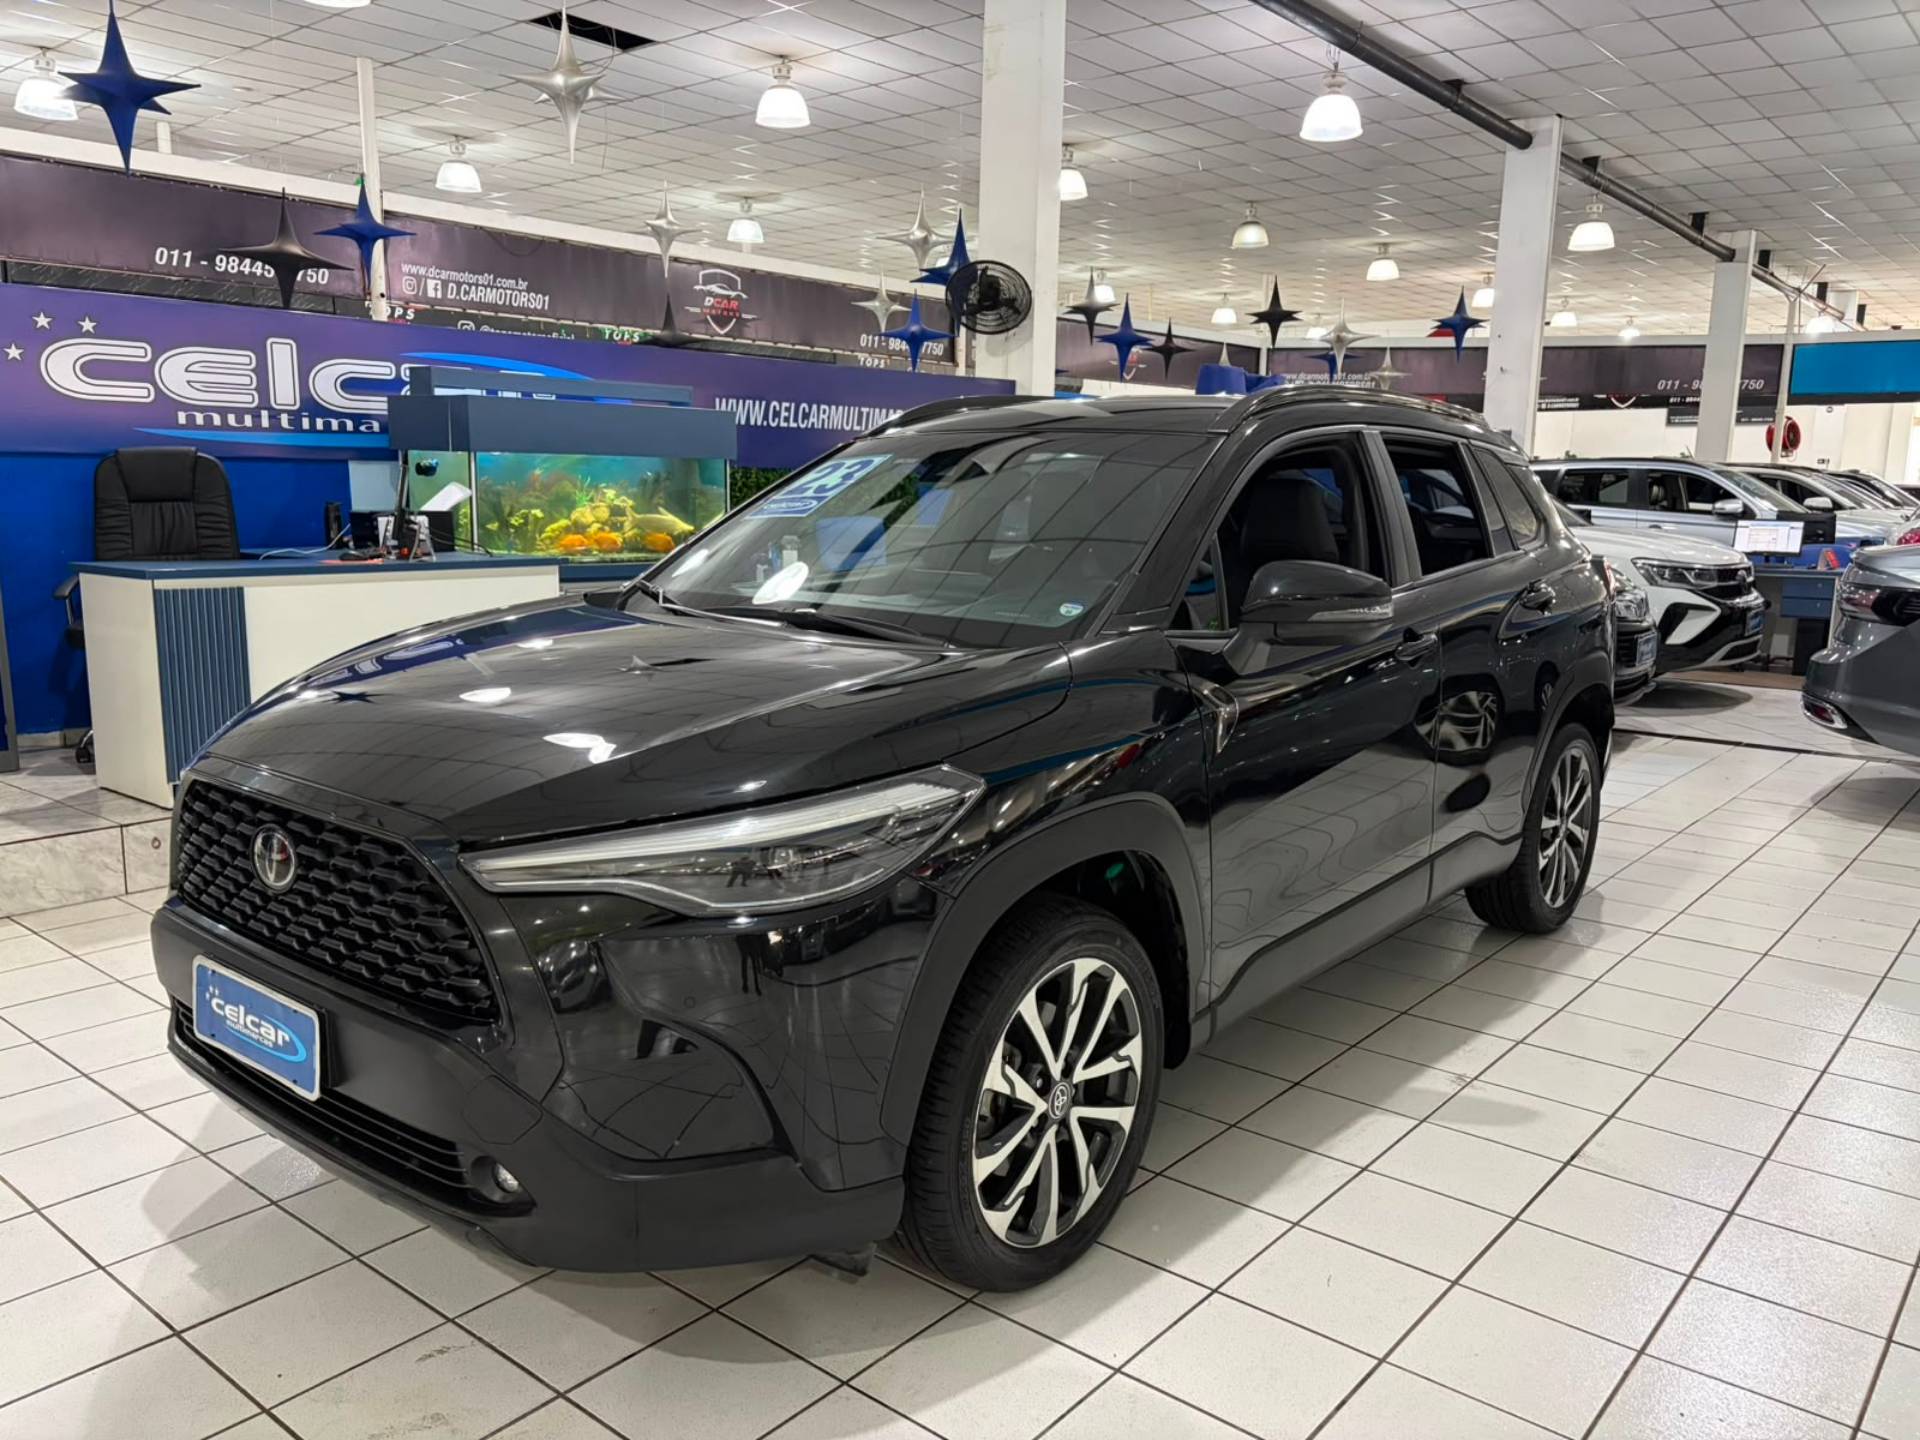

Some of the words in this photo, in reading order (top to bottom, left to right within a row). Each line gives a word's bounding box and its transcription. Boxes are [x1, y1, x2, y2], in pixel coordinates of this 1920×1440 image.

[155, 247, 192, 267] 011
[401, 263, 528, 290] www.dcarmotors01.com.br
[447, 283, 550, 310] D.CARMOTORS01
[704, 297, 739, 310] DCAR
[860, 334, 878, 348] 011
[1657, 380, 1680, 390] 011
[177, 409, 380, 432] multima
[781, 458, 875, 496] 23
[211, 997, 290, 1047] celcar
